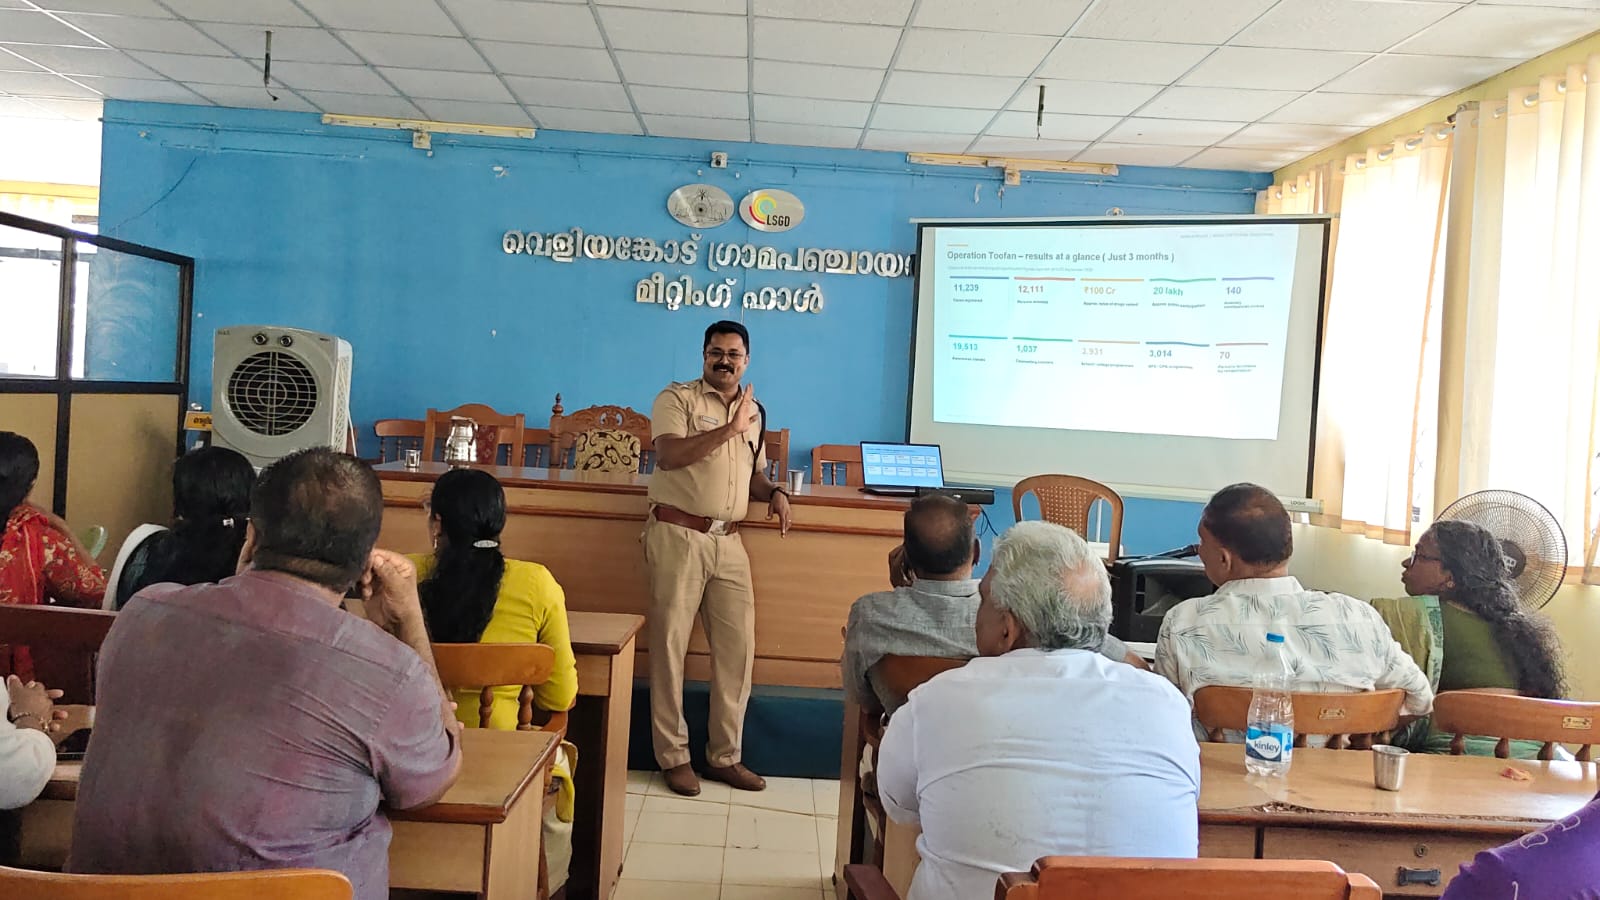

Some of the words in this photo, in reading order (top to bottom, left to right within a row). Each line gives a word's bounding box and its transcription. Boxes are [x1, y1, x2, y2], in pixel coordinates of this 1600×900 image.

[767, 215, 791, 227] LSGD
[502, 227, 703, 265] വെളിയങ്കോട്
[708, 241, 911, 277] ഗ്രാമപഞ്ചായ
[947, 251, 987, 260] Operation
[989, 251, 1017, 260] Toofan
[1025, 252, 1054, 260] results
[1055, 252, 1064, 261] at
[1072, 253, 1101, 263] glance
[1107, 253, 1127, 261] Just
[1128, 253, 1134, 261] 3
[1136, 253, 1169, 261] months
[636, 271, 737, 311] മീറ്റിംഗ്
[742, 282, 824, 314] ഹാൾ
[954, 284, 979, 292] 11,239
[1018, 285, 1044, 293] 12,111
[1105, 287, 1116, 295] Cr
[1153, 287, 1164, 295] 20
[1165, 287, 1184, 296] lakh
[1226, 286, 1242, 295] 140
[1017, 345, 1038, 353] 1,037
[1220, 351, 1231, 359] 70
[1254, 741, 1279, 753] kinley
